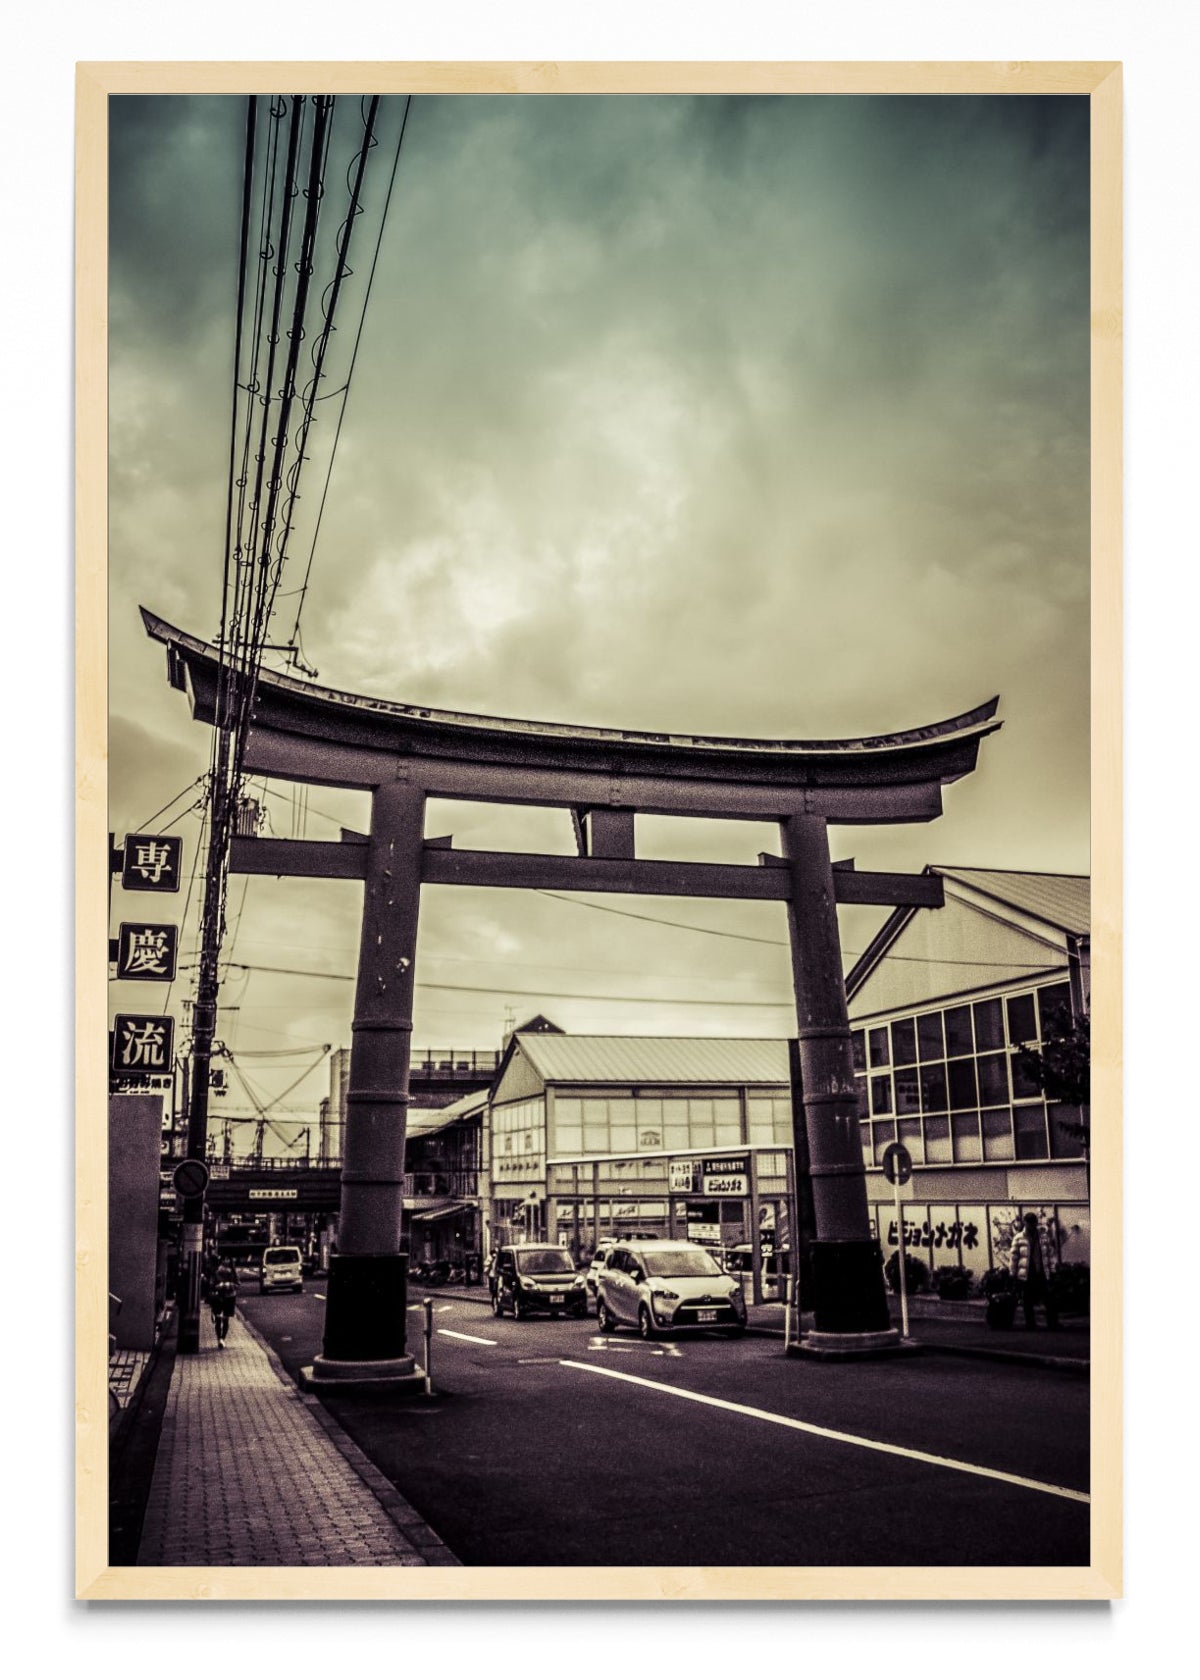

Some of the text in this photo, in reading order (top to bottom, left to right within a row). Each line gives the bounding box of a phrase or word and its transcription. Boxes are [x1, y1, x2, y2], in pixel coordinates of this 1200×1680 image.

[888, 1219, 979, 1250] ビジョンメガネ
